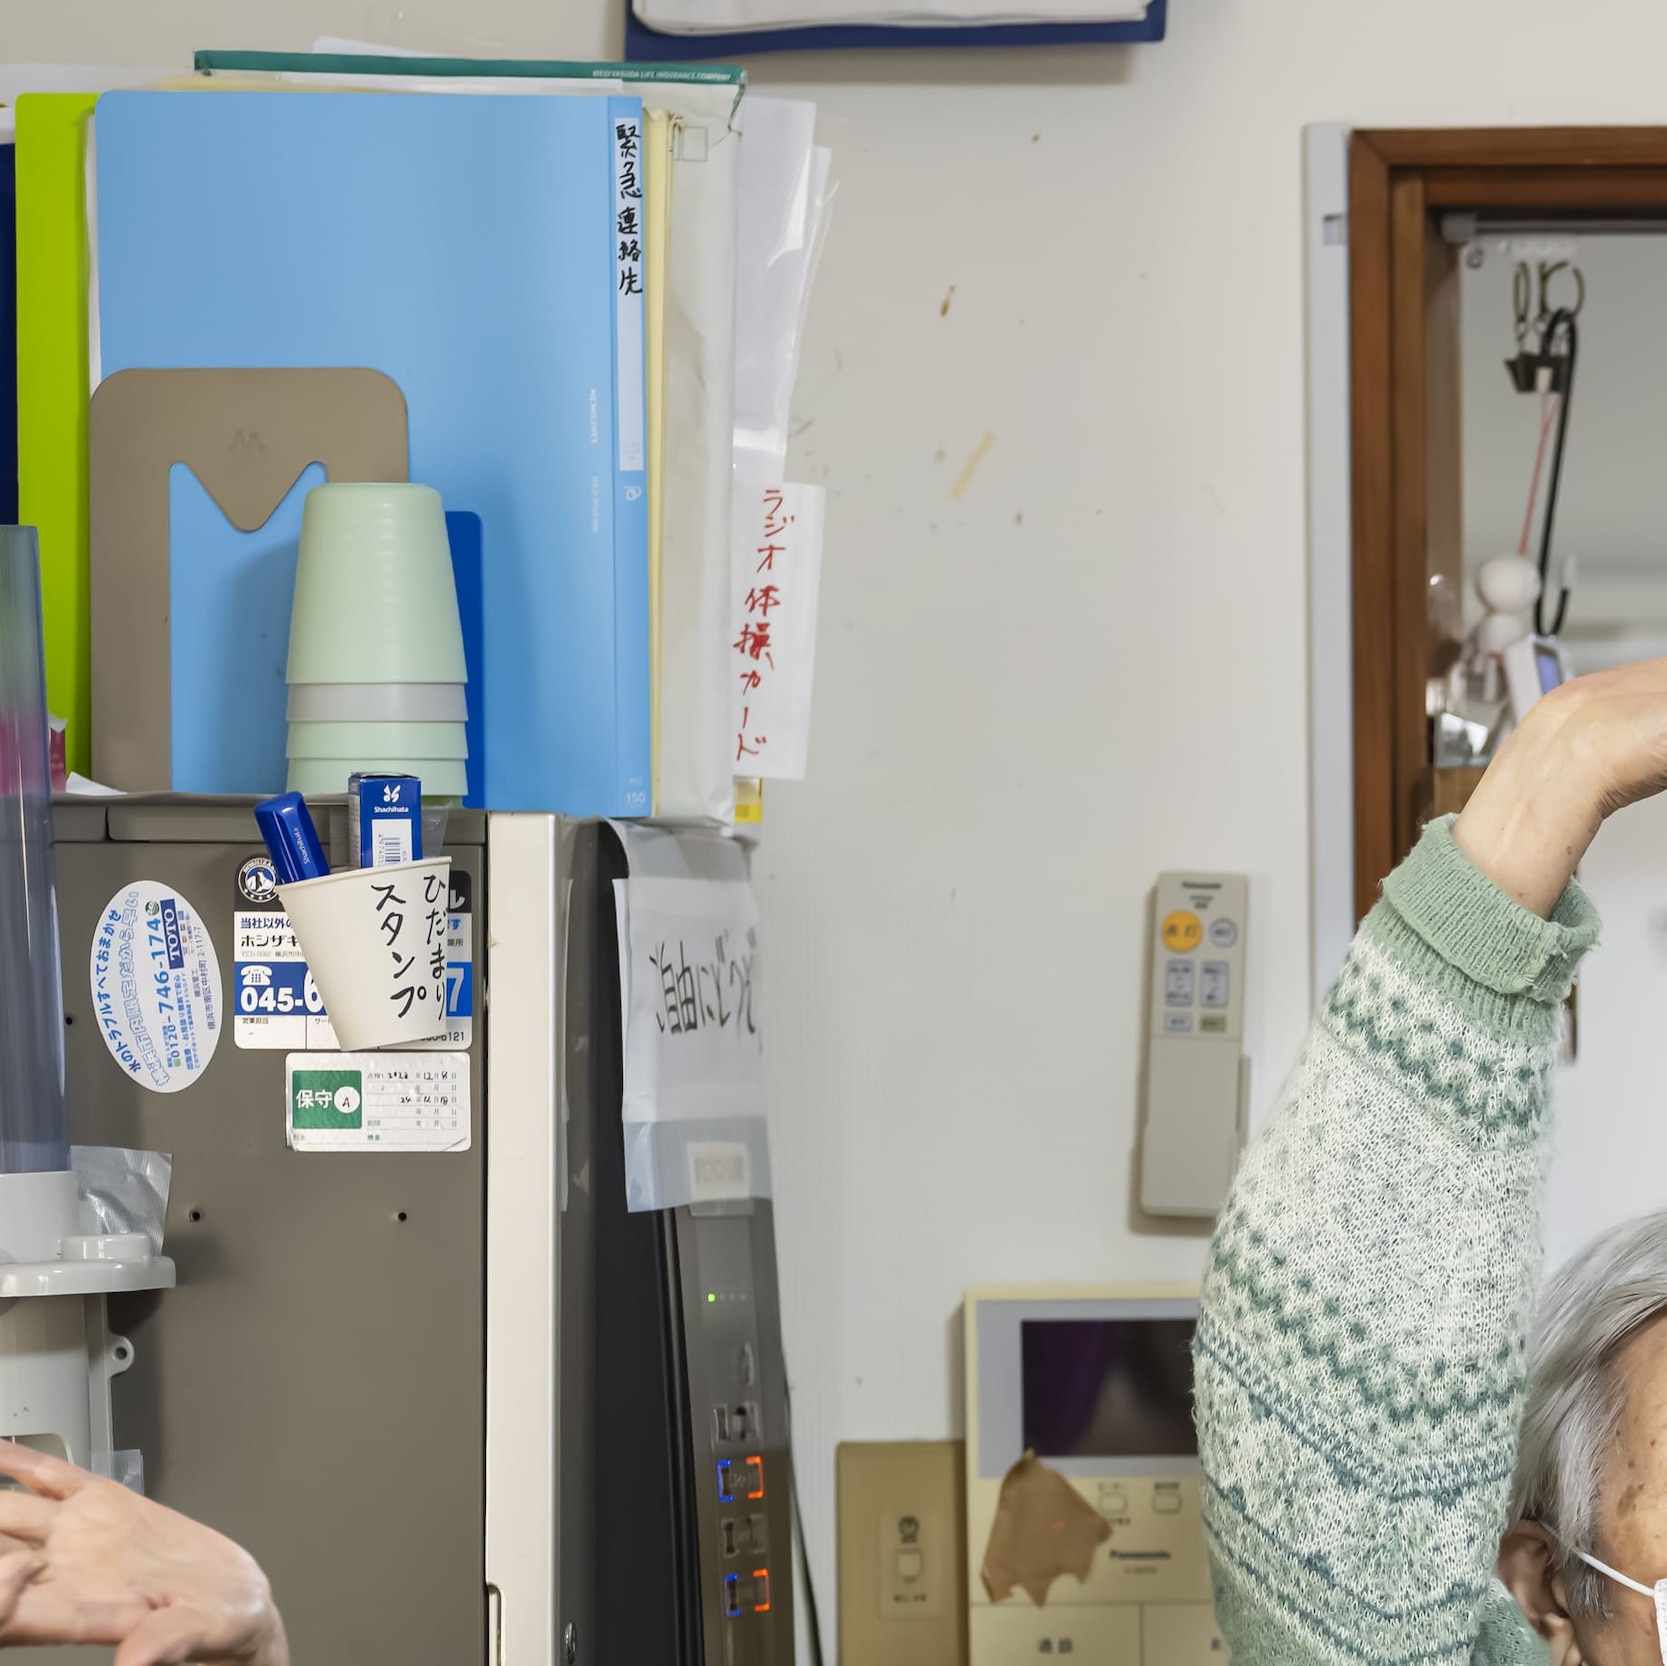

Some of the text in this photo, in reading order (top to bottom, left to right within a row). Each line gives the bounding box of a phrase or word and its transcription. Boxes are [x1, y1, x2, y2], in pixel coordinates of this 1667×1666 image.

[616, 124, 643, 296] 緊急連絡先
[733, 489, 794, 761] ラジオ体操カード
[374, 806, 409, 814] Shachihata
[146, 917, 181, 1059] 0120-746-174
[163, 908, 180, 962] TOTO
[241, 934, 298, 948] ホシザキ
[371, 884, 426, 1018] スタンプ
[423, 874, 447, 1020] ひだまり
[295, 1089, 350, 1109] 保守 A
